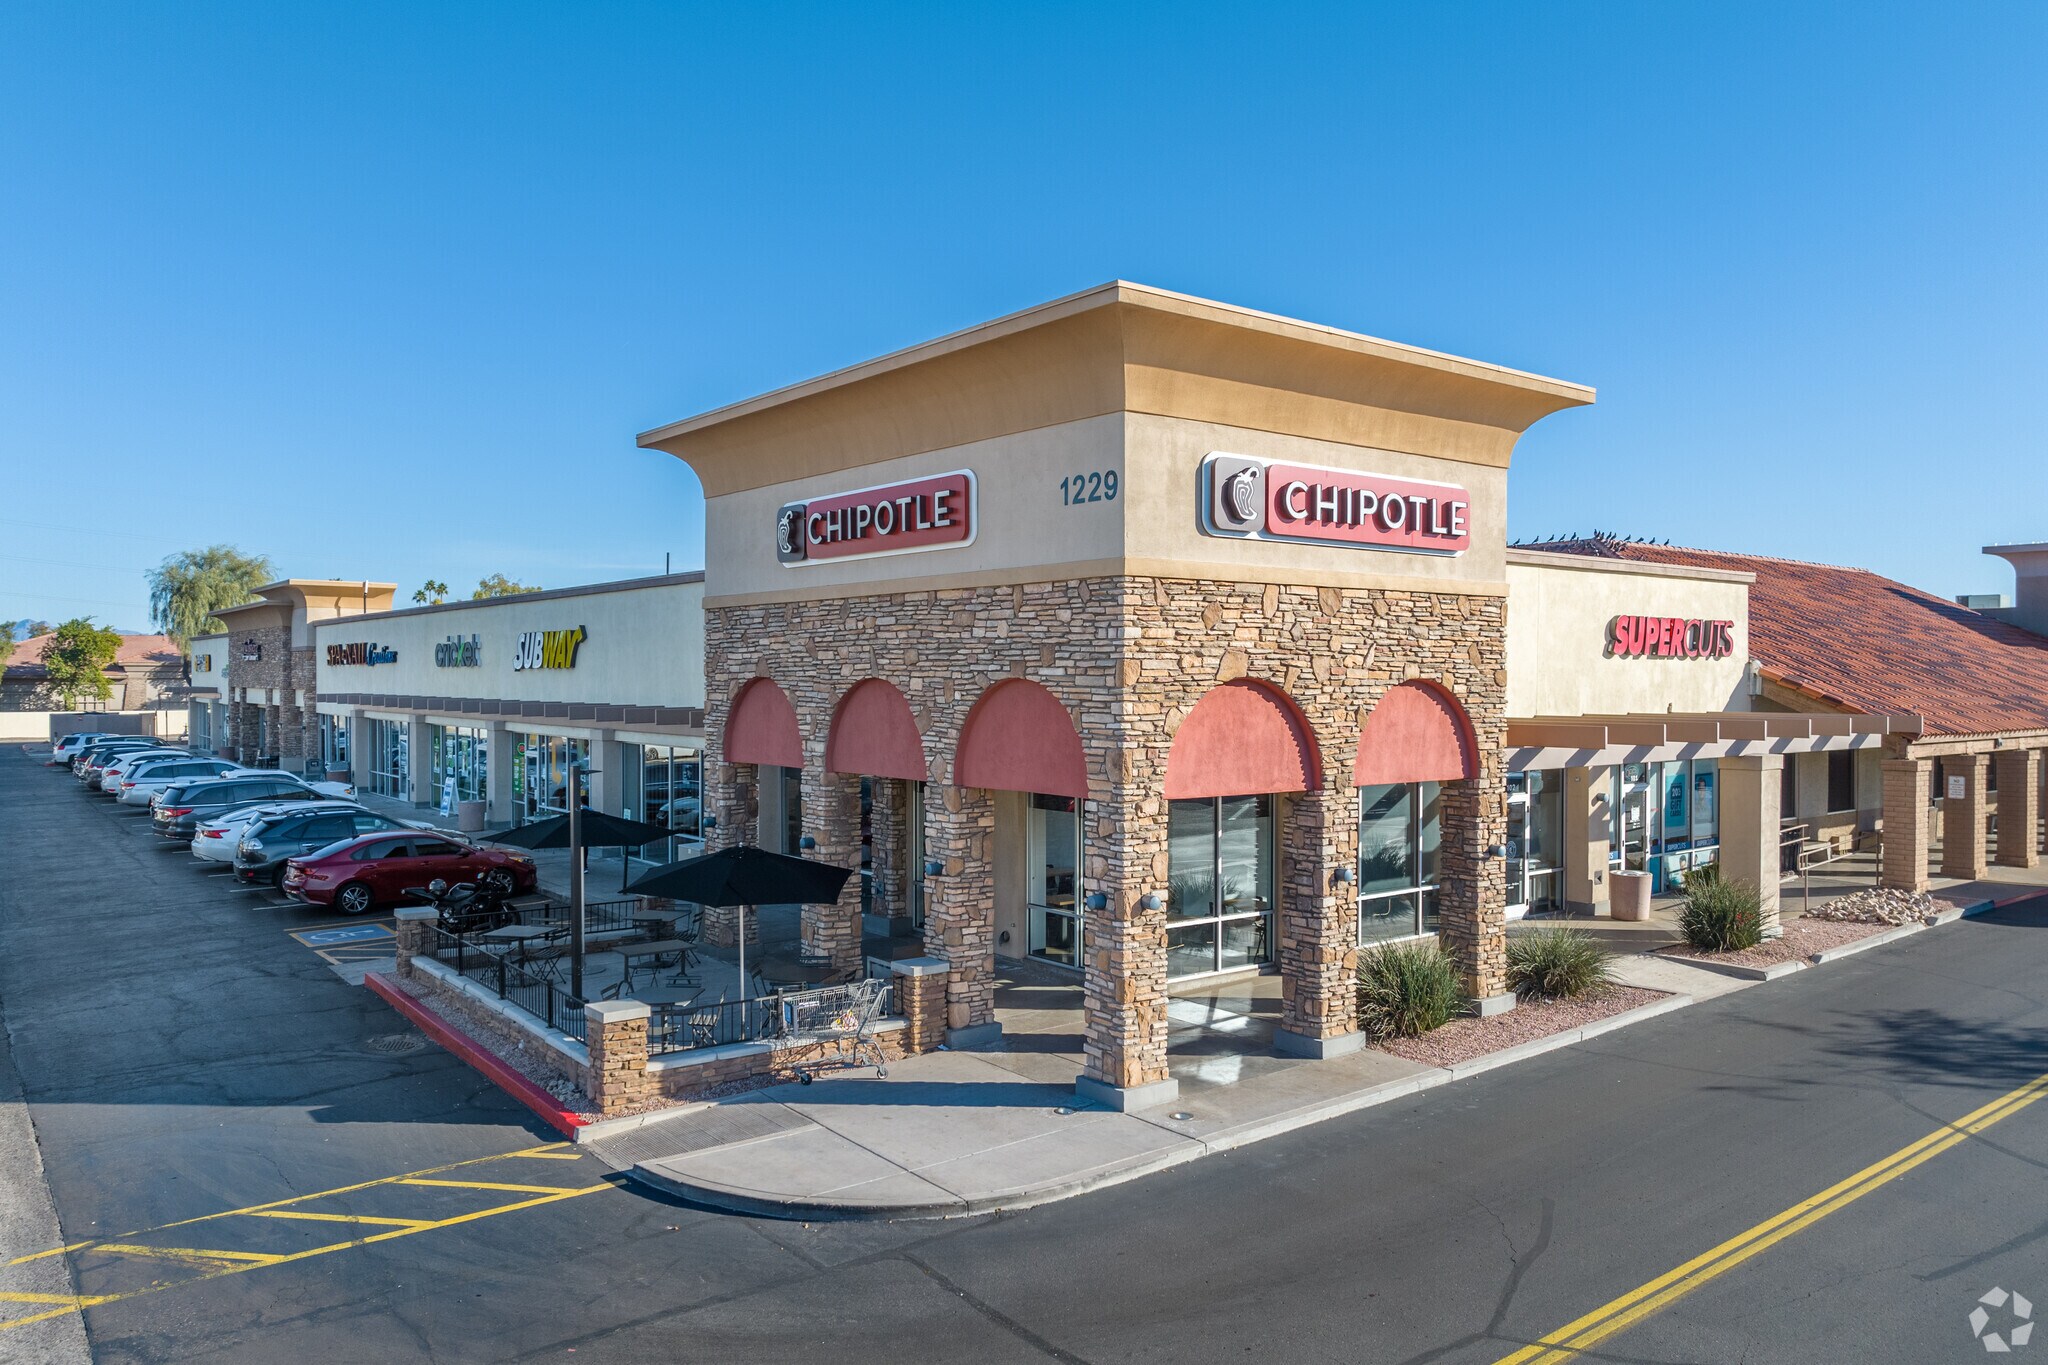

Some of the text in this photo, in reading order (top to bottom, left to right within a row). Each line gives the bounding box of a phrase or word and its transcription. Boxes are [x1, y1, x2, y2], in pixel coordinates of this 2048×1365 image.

[1060, 469, 1118, 506] 1229
[1281, 480, 1468, 536] CHIPOTLE
[808, 489, 954, 545] CHIPOTLE
[434, 634, 479, 667] cricket
[513, 626, 586, 670] SUBWAY
[1612, 614, 1735, 658] SUPERCUTS
